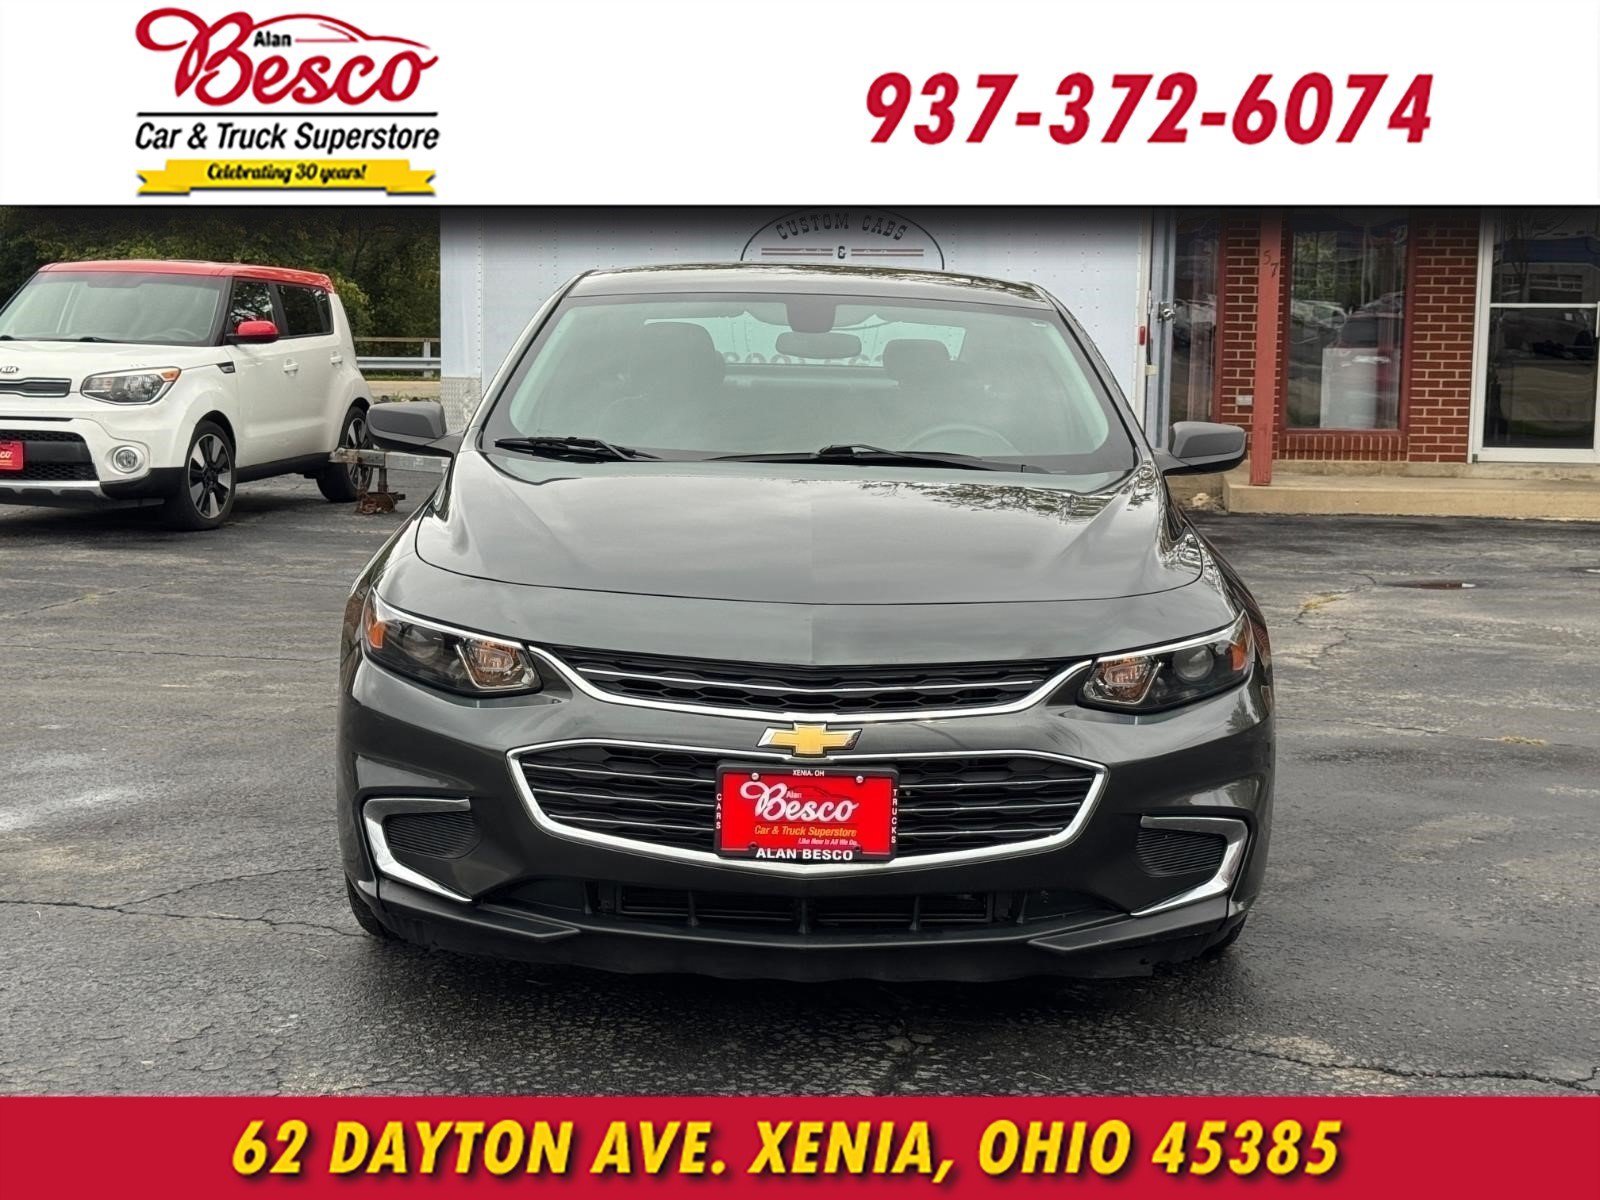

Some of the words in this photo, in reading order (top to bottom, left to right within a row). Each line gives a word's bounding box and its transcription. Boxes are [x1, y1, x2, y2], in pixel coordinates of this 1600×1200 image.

[776, 212, 849, 240] CUSTOM
[862, 214, 908, 240] CABS
[837, 246, 846, 259] &
[740, 781, 859, 822] Besco
[786, 791, 802, 799] Alan
[715, 793, 723, 830] CARS
[891, 788, 899, 844] TRUCKS
[754, 825, 770, 835] Car
[773, 827, 780, 835] &
[782, 826, 806, 836] Truck
[808, 826, 857, 837] Superstore
[756, 848, 797, 859] ALAN
[802, 849, 854, 861] BESCO
